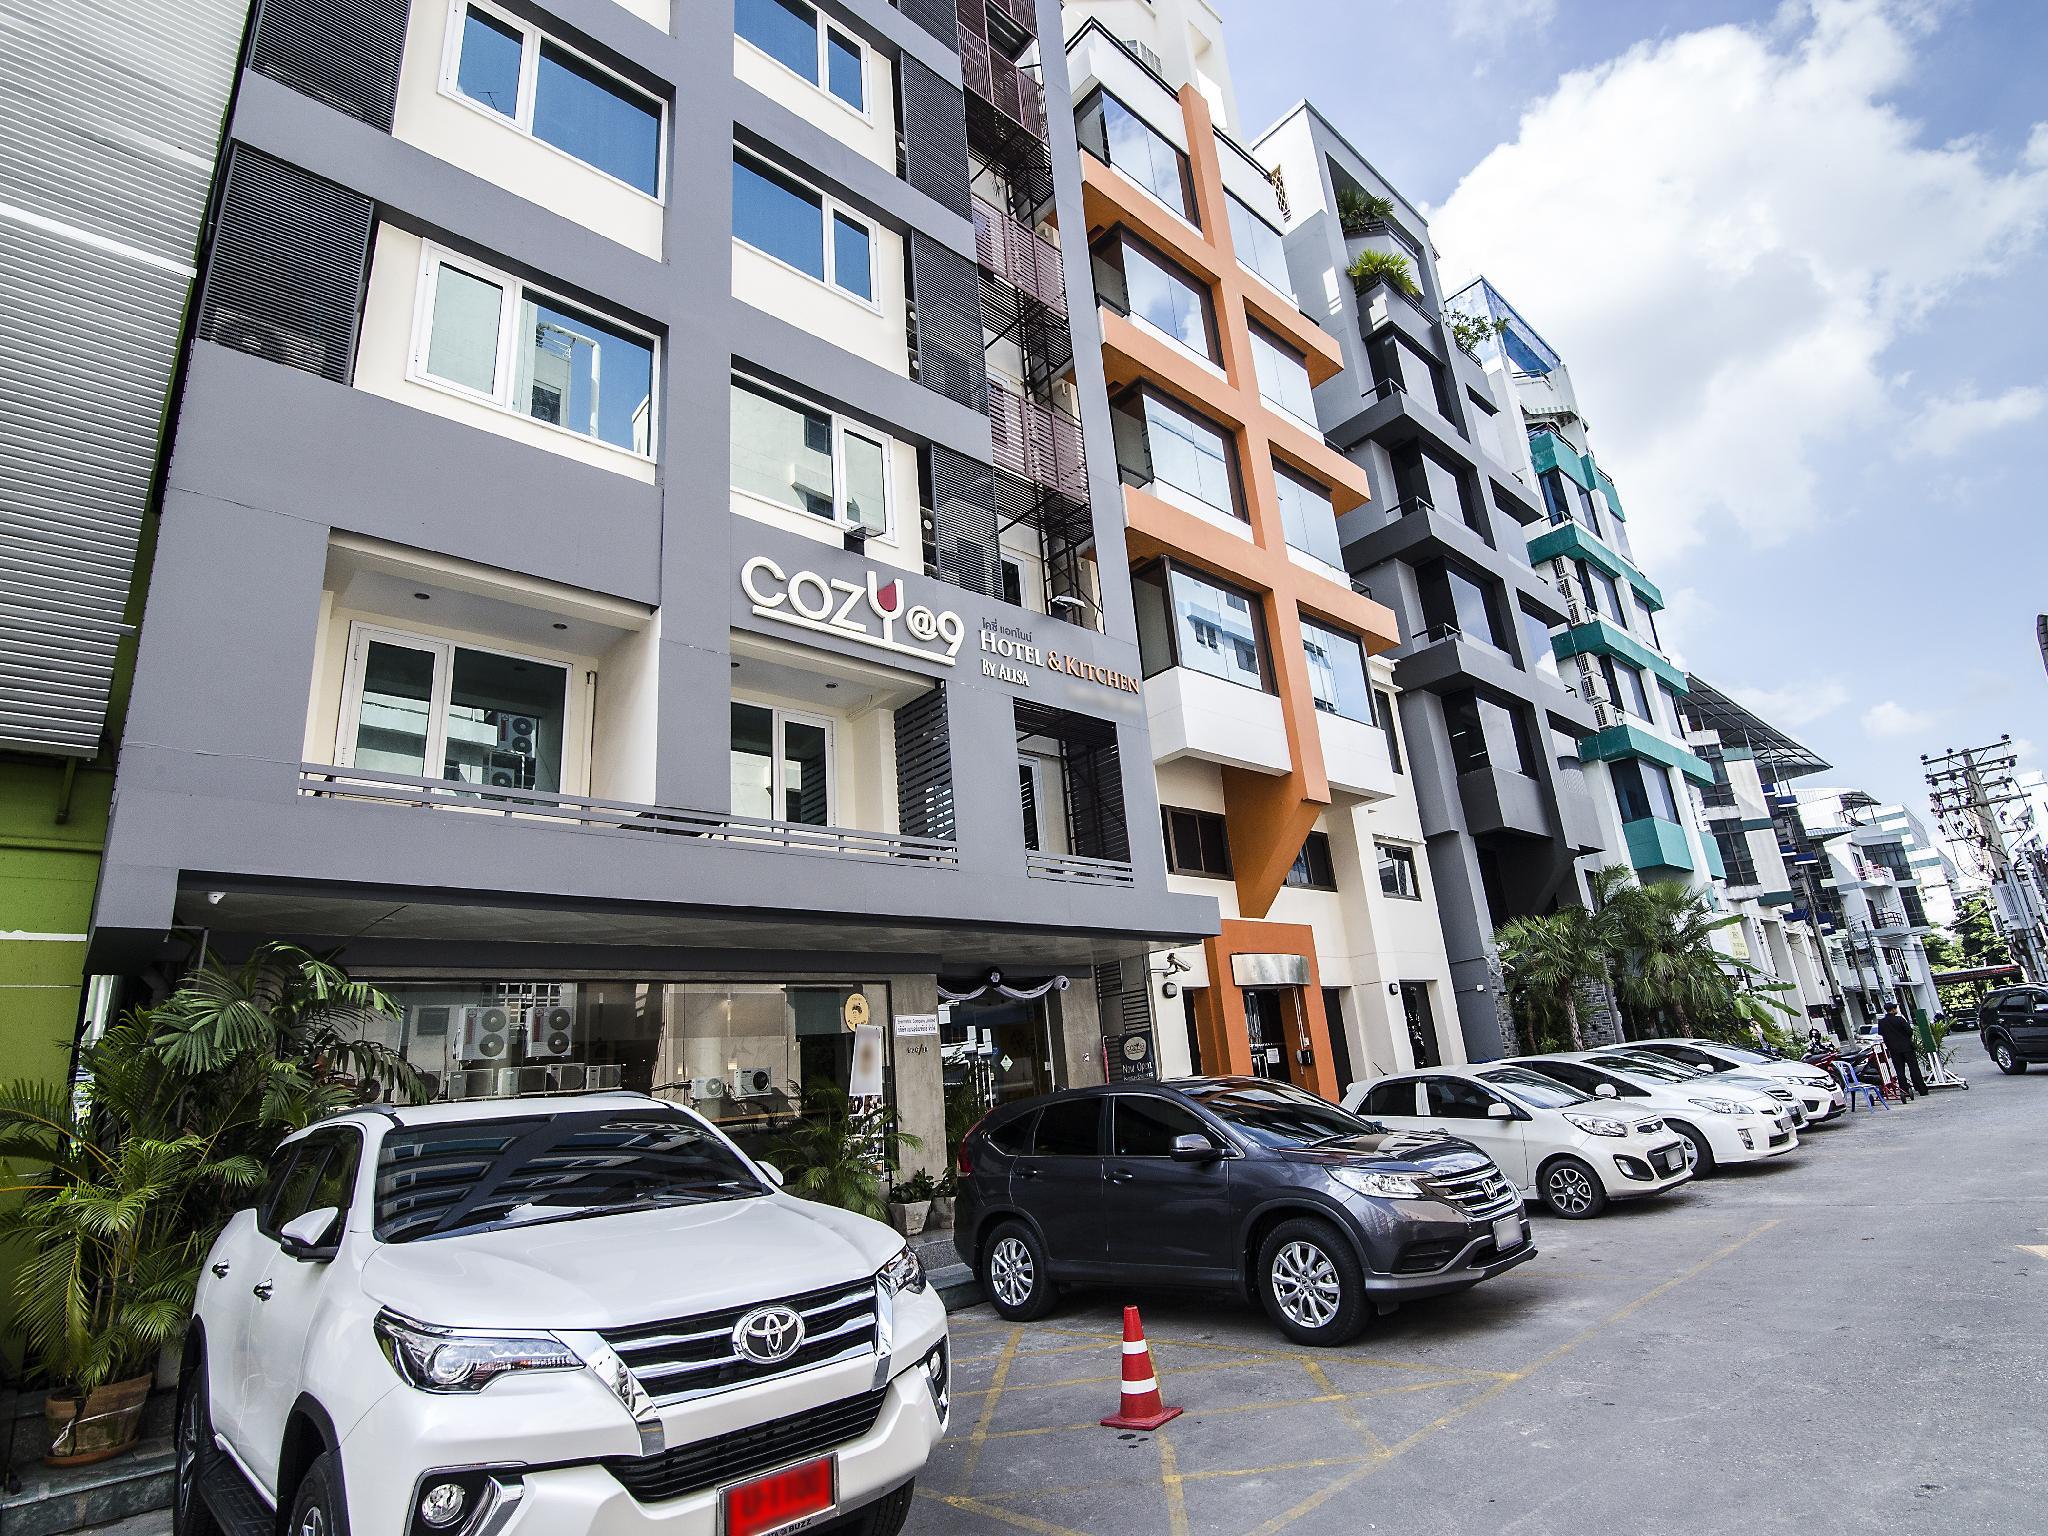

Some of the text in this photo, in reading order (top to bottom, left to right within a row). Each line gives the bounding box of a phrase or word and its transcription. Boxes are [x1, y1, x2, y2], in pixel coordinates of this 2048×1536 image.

[979, 629, 1140, 695] HOTEL & KITCHEN
[981, 658, 1031, 688] BY ALISA
[788, 1519, 812, 1533] BUZZ
